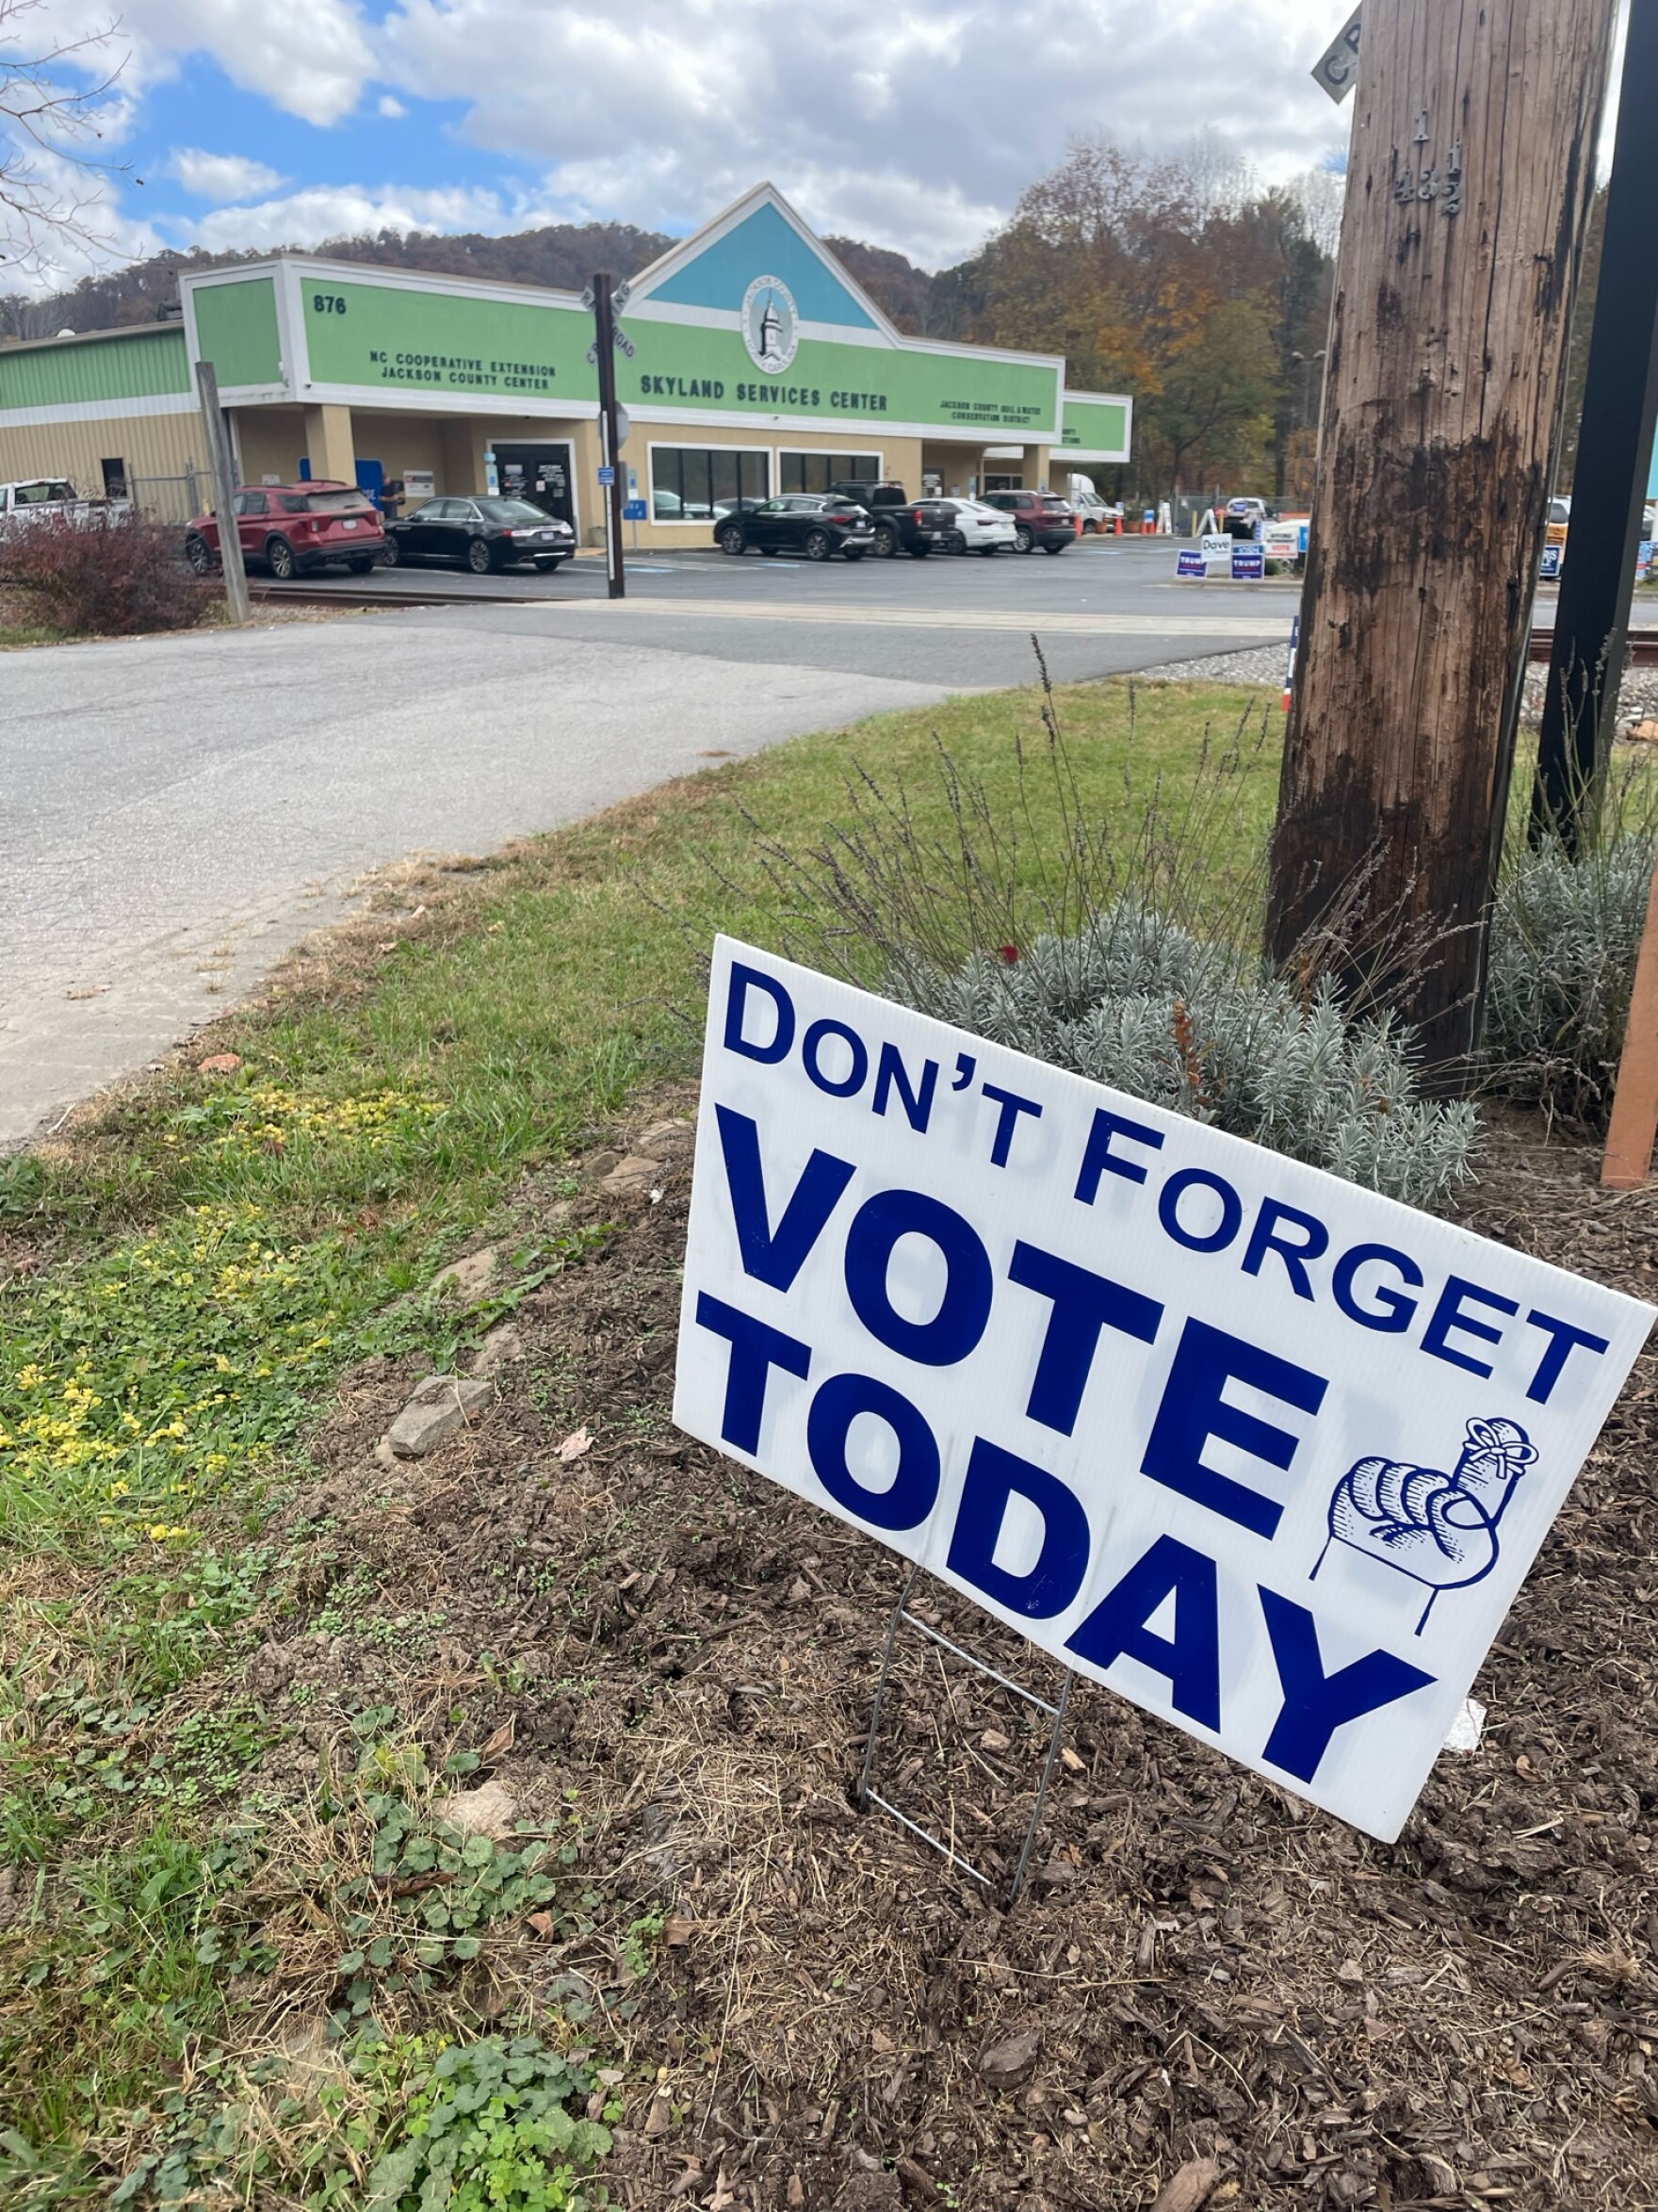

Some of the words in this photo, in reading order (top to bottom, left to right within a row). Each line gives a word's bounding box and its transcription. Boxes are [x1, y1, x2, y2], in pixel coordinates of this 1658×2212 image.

[314, 295, 347, 315] 876
[370, 350, 388, 364] NC
[396, 353, 482, 372] COOPERATIVE
[491, 362, 556, 378] EXTENSION
[382, 366, 442, 382] JACKSON
[449, 372, 497, 386] COUNTY
[504, 377, 548, 390] CENTER
[641, 375, 724, 399] SKYLAND
[737, 383, 821, 407] SERVICES
[831, 391, 887, 412] CENTER
[1204, 540, 1230, 549] Dave
[723, 961, 1044, 1169] DON'T
[1074, 1107, 1610, 1405] FORGET
[715, 1103, 1329, 1540] VOTE
[696, 1291, 1437, 1783] TODAY
